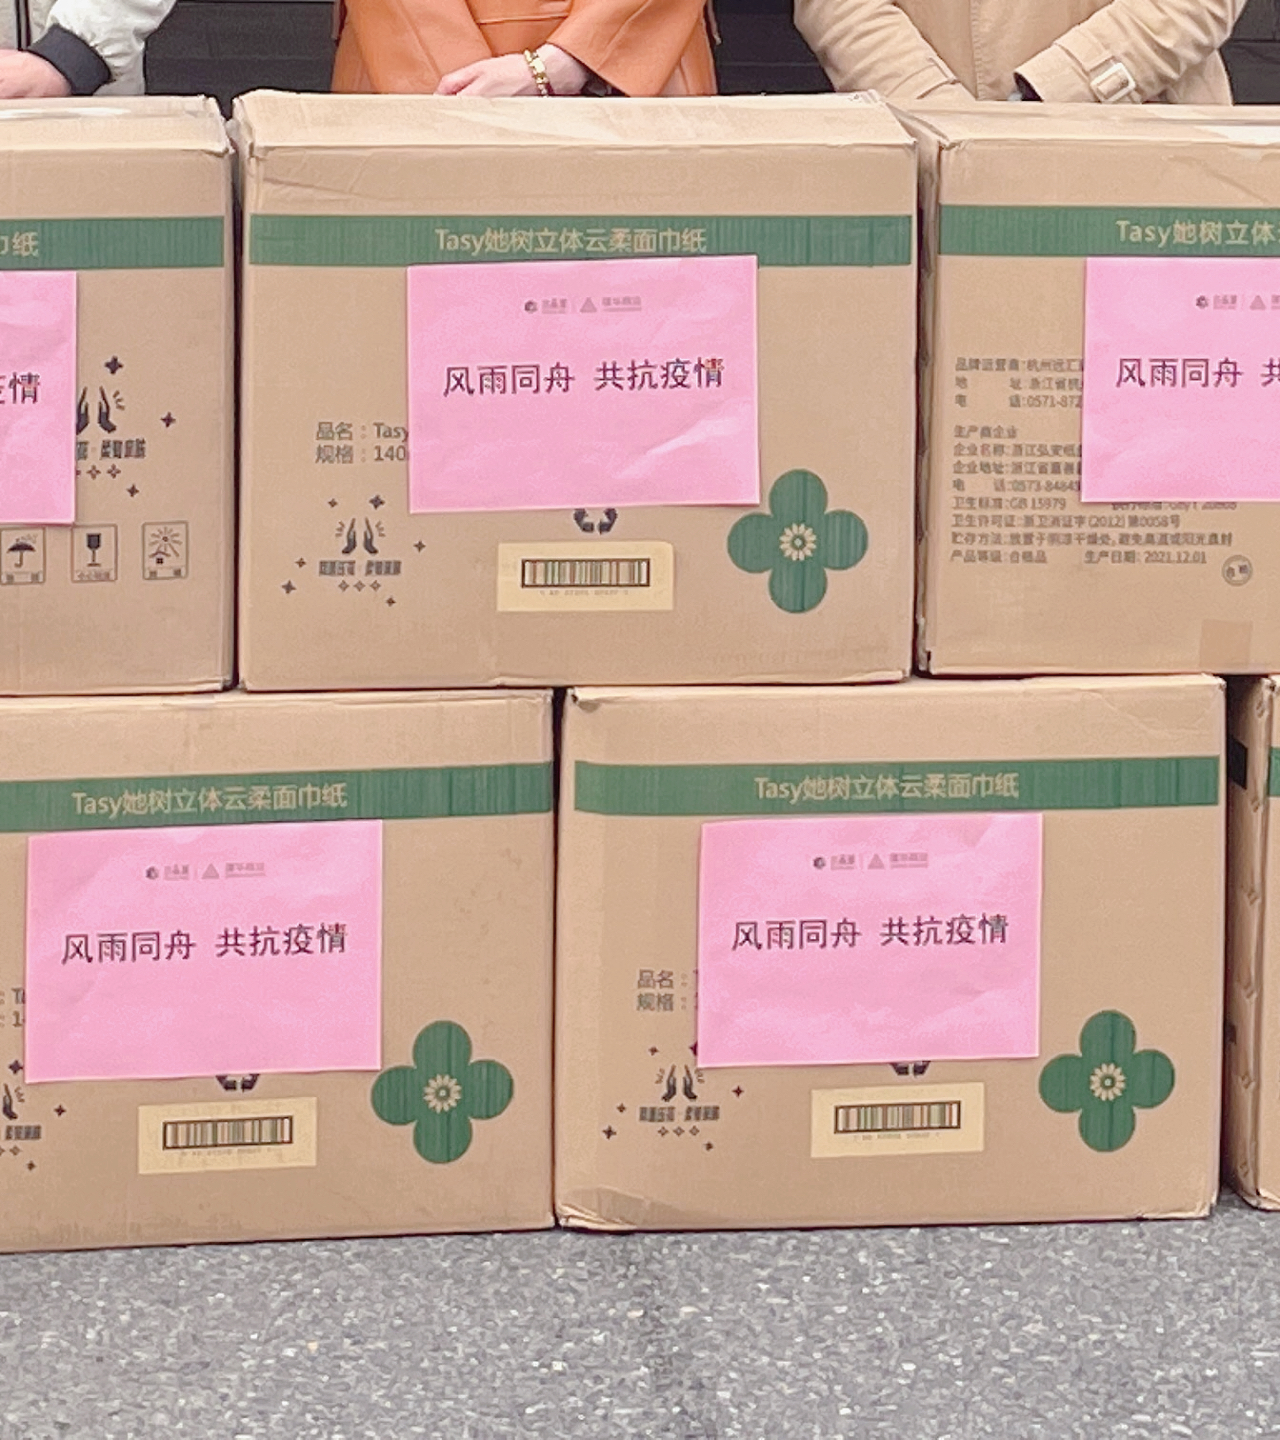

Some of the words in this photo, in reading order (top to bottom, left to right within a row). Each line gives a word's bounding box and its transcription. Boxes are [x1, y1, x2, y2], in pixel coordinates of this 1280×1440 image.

[435, 227, 706, 255] Tasy她树立体云柔面巾纸
[443, 362, 576, 397] 风雨同舟
[594, 356, 724, 390] 共抗疫情
[1116, 358, 1243, 388] 风雨同舟
[72, 783, 347, 817] Tasy她树立体云柔面巾纸
[755, 773, 1018, 803] Tasy她树立体云柔面巾纸
[62, 931, 196, 965] 风雨同舟
[215, 923, 347, 958] 共抗疫情
[732, 919, 862, 951] 风雨同舟
[880, 913, 1009, 946] 共抗疫情
